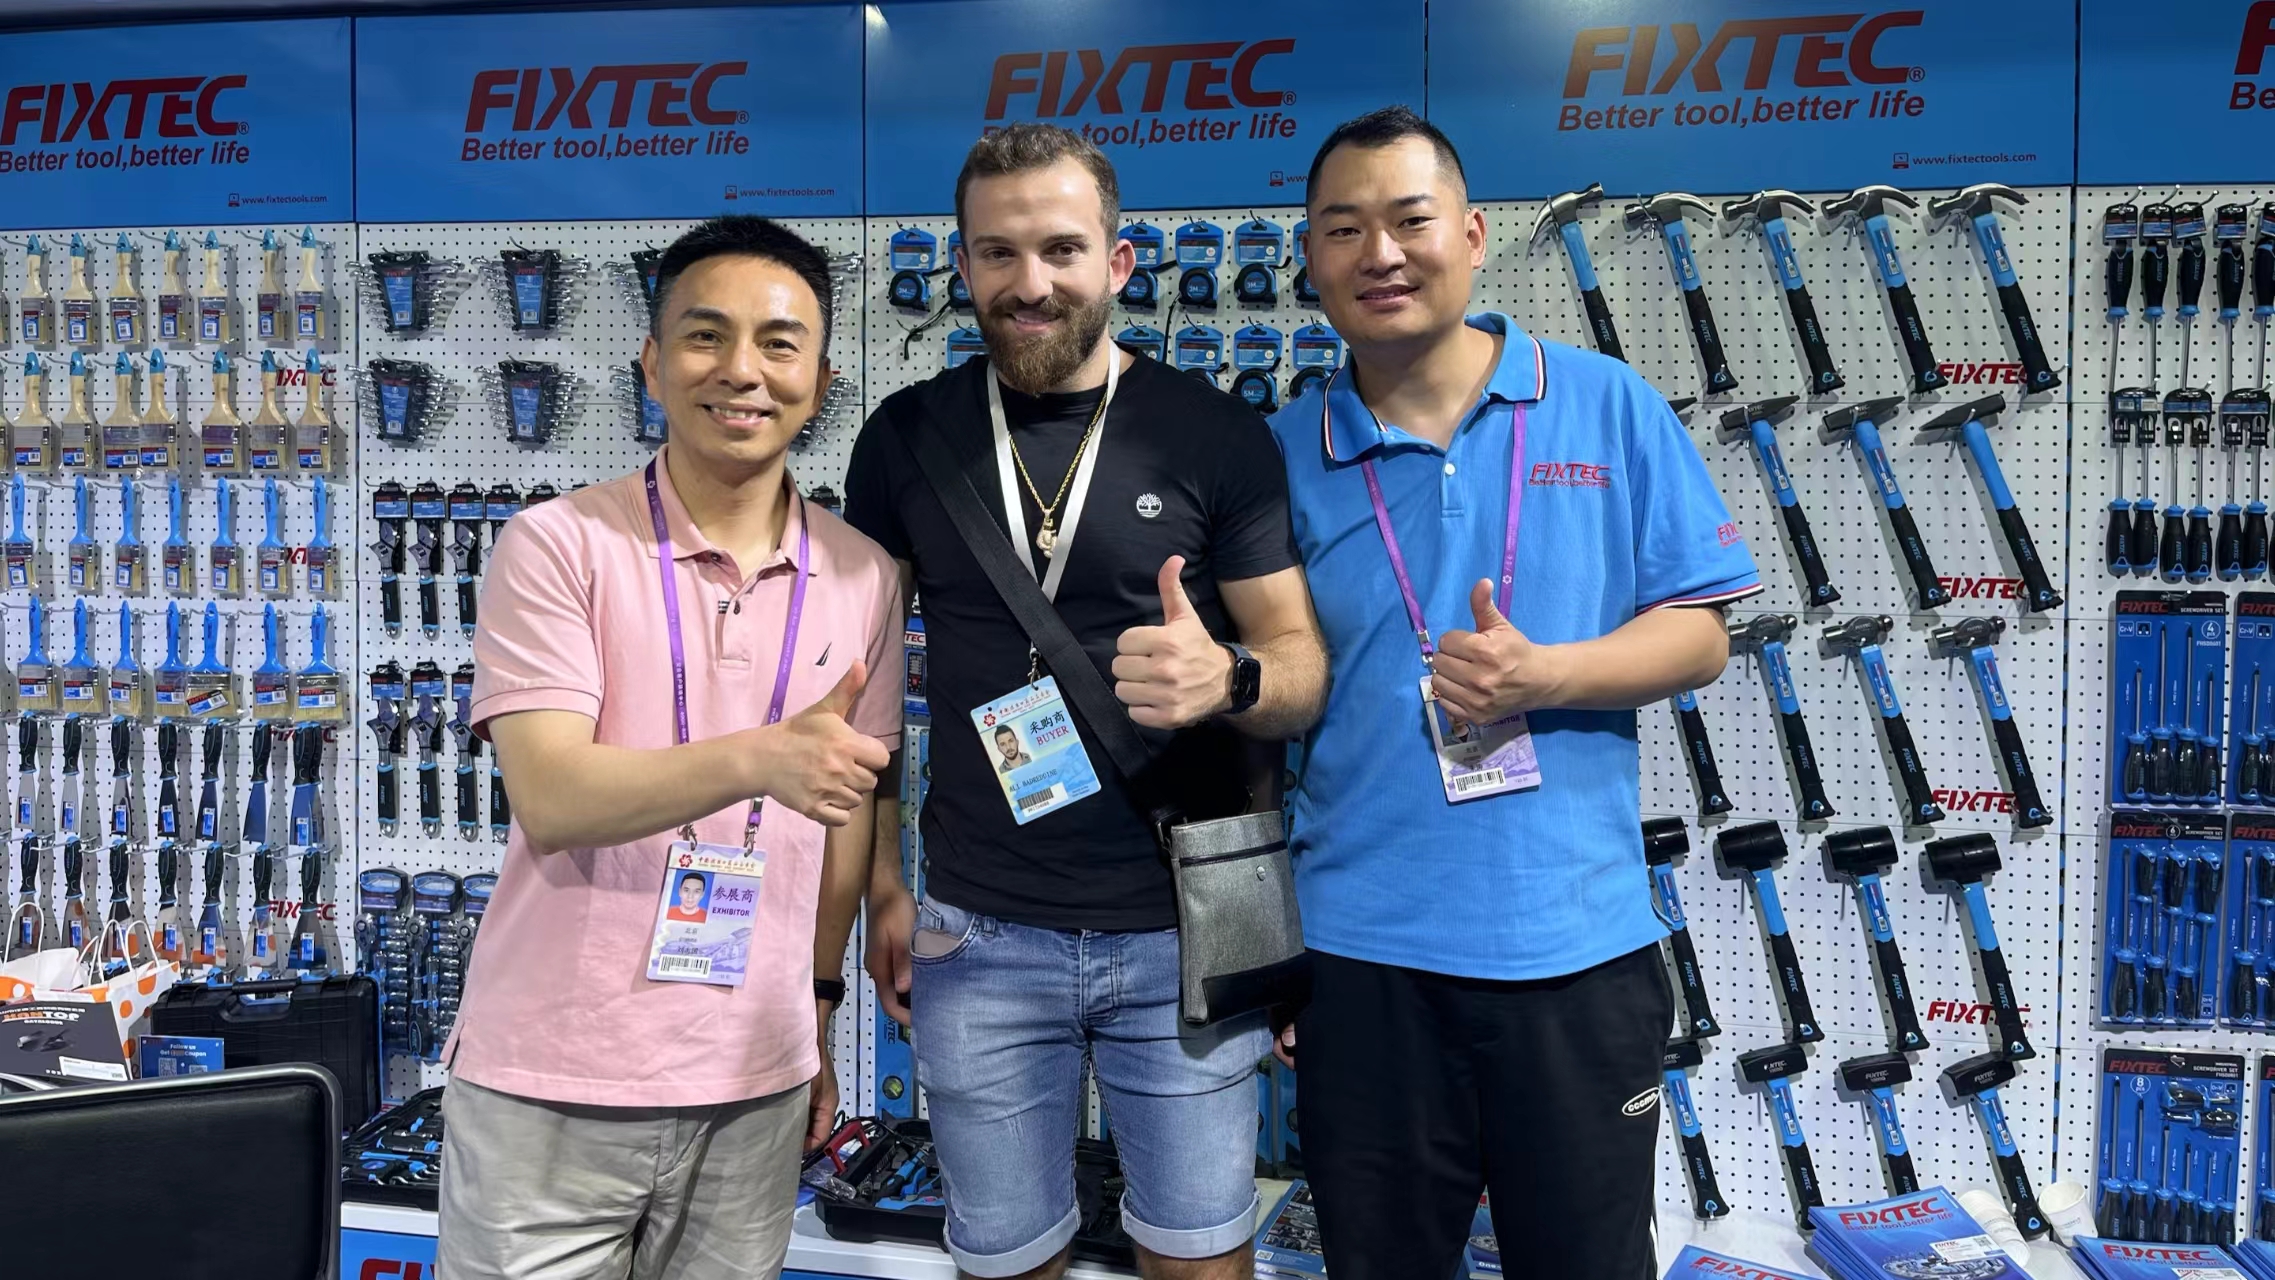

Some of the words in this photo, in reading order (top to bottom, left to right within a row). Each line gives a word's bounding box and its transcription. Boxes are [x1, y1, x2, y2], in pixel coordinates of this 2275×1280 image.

[1562, 10, 1924, 98] FIXTEC
[984, 38, 1296, 120] FIXTEC
[465, 61, 748, 132] FIXTEC
[0, 75, 247, 145] FIXTEC
[1557, 103, 1663, 131] Better
[1674, 95, 1858, 128] tool,better
[1868, 89, 1925, 119] life
[1248, 113, 1297, 139] life
[461, 137, 545, 162] Better
[553, 133, 699, 160] tool,better
[706, 130, 749, 155] life
[0, 149, 68, 173] Better
[75, 143, 204, 171] tool,better
[211, 141, 249, 164] life
[1913, 151, 2037, 166] www.fixtectools.com
[242, 194, 327, 205] www.fixtectools.com
[740, 187, 835, 198] www.fixtectools.com
[1532, 462, 1610, 481] FIXTEC
[2119, 601, 2168, 613] FIXTEC
[2207, 623, 2214, 632] 4
[1030, 710, 1065, 734] 采购商
[1036, 726, 1070, 745] BUYER
[2113, 825, 2162, 837] FIXTEC
[713, 886, 755, 903] 参展商
[712, 907, 750, 917] EXHIBITOR
[2109, 1060, 2168, 1073] FIXTEC
[2137, 1077, 2144, 1085] 8
[1838, 1197, 1944, 1226] FIXTEC
[2103, 1244, 2218, 1261] FIXTEC
